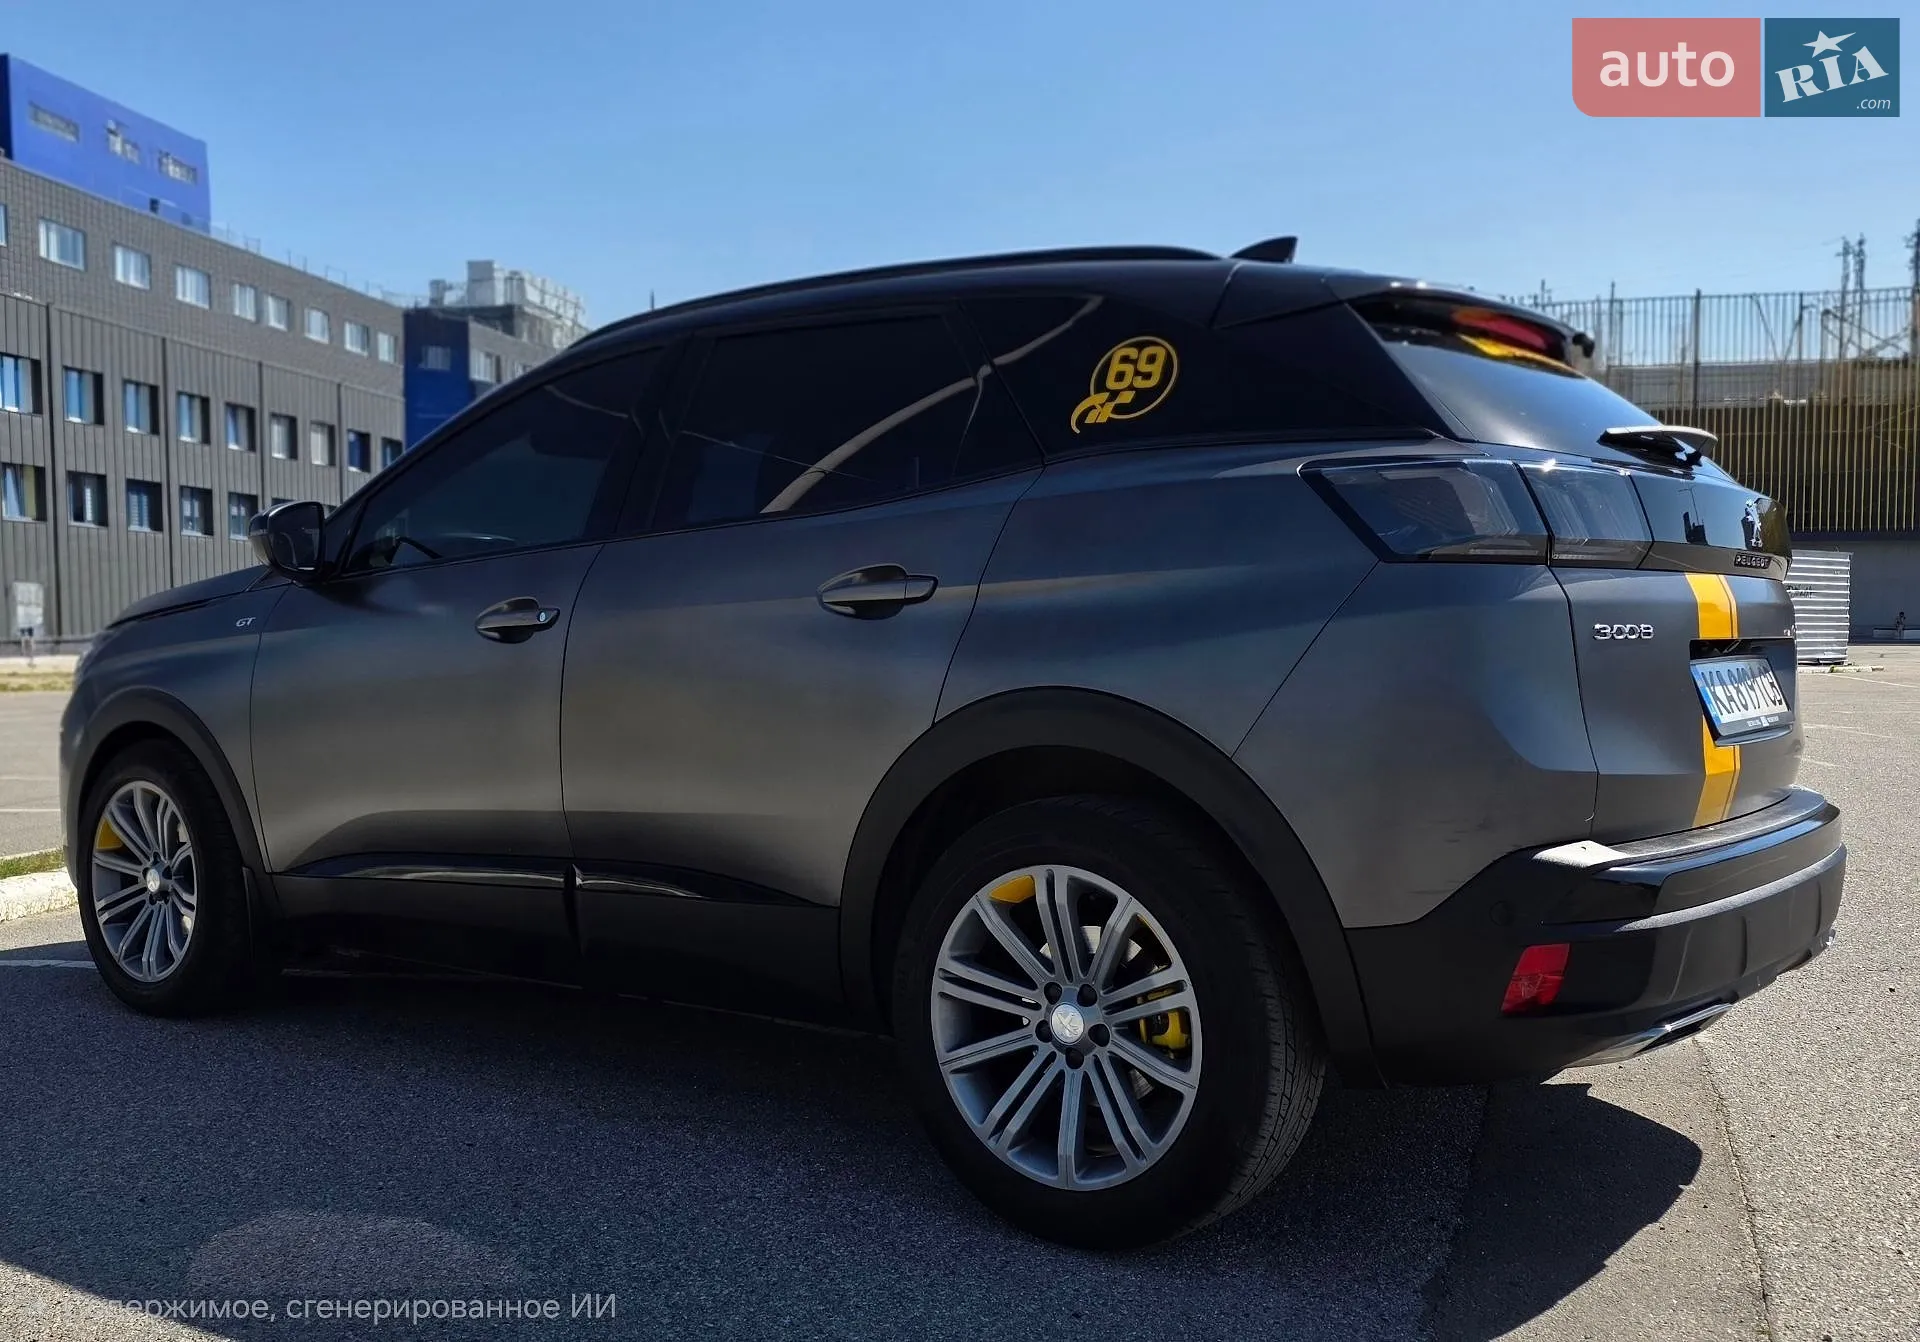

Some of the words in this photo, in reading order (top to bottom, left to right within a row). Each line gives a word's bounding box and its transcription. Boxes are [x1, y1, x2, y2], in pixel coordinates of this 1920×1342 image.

[1105, 345, 1166, 390] 69
[236, 617, 256, 627] GT
[1594, 623, 1654, 640] 3008
